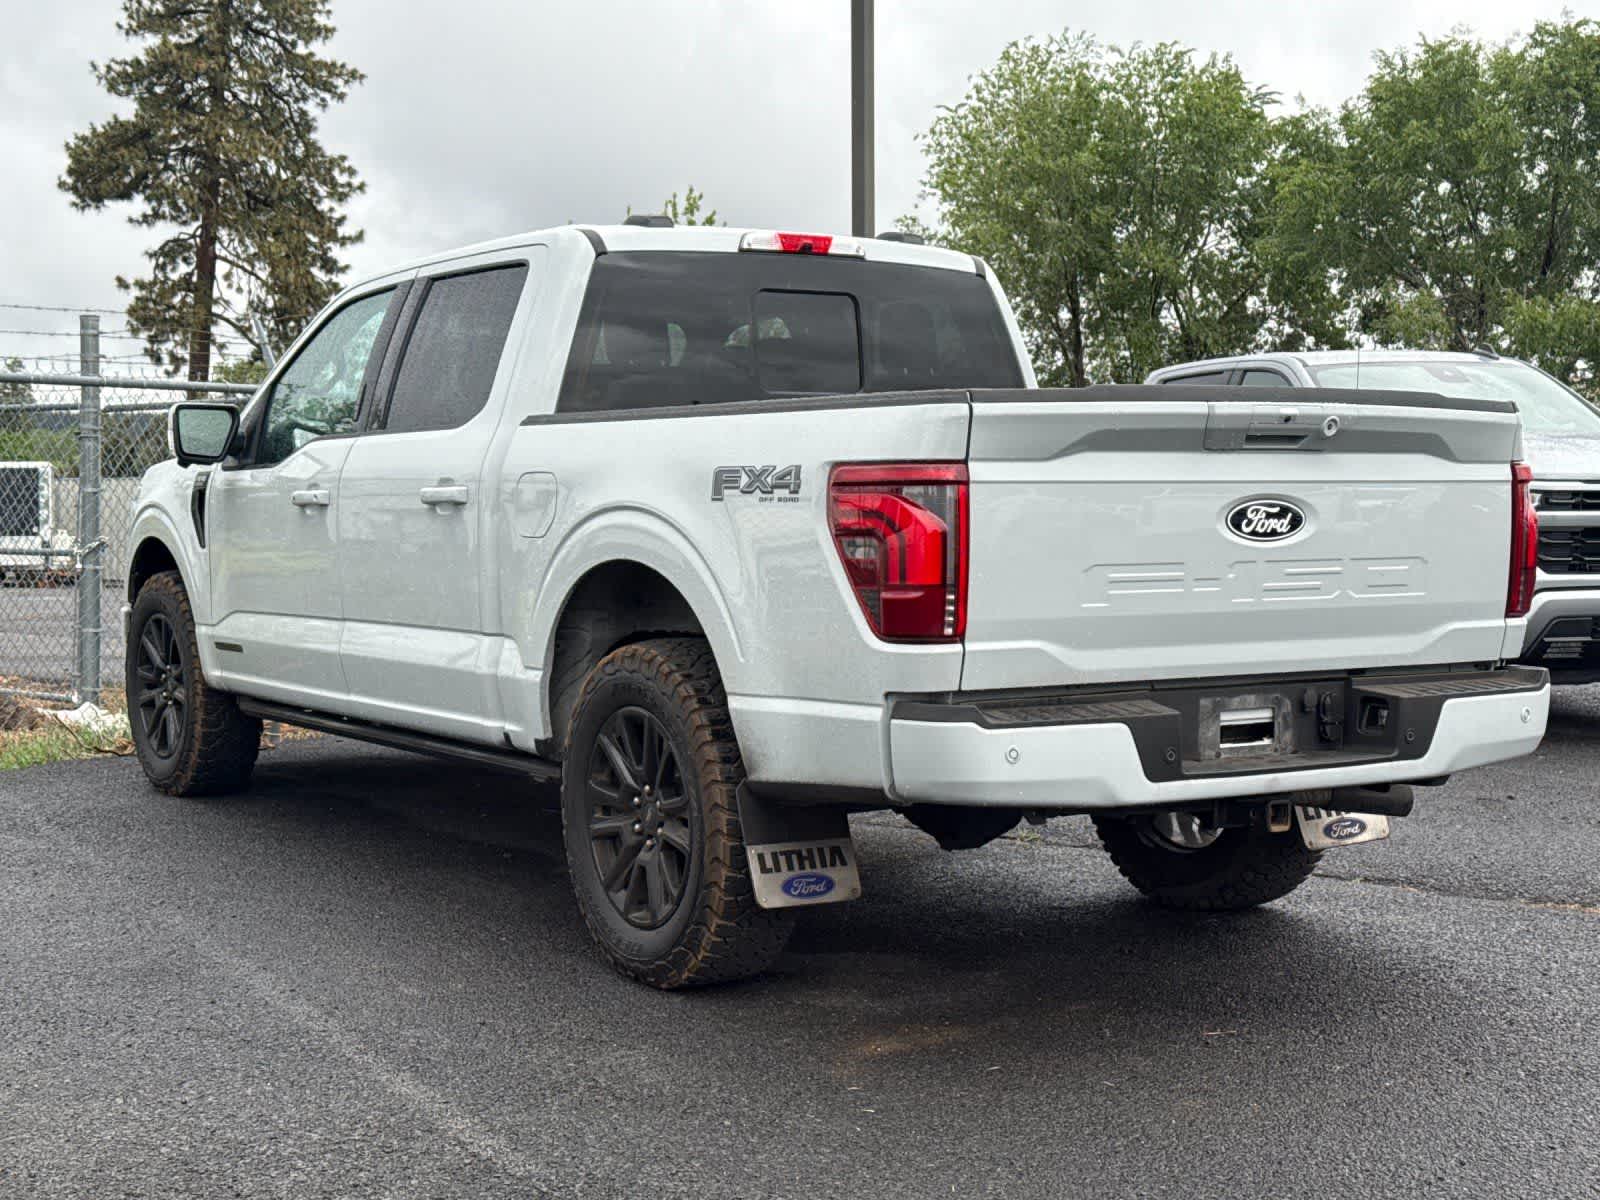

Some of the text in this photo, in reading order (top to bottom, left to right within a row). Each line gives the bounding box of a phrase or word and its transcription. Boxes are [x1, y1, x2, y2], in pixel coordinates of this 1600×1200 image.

[711, 464, 801, 501] FX4
[1241, 505, 1293, 533] Ford
[1331, 821, 1360, 838] Ford
[757, 846, 848, 874] LITHIA
[790, 878, 826, 895] Ford
